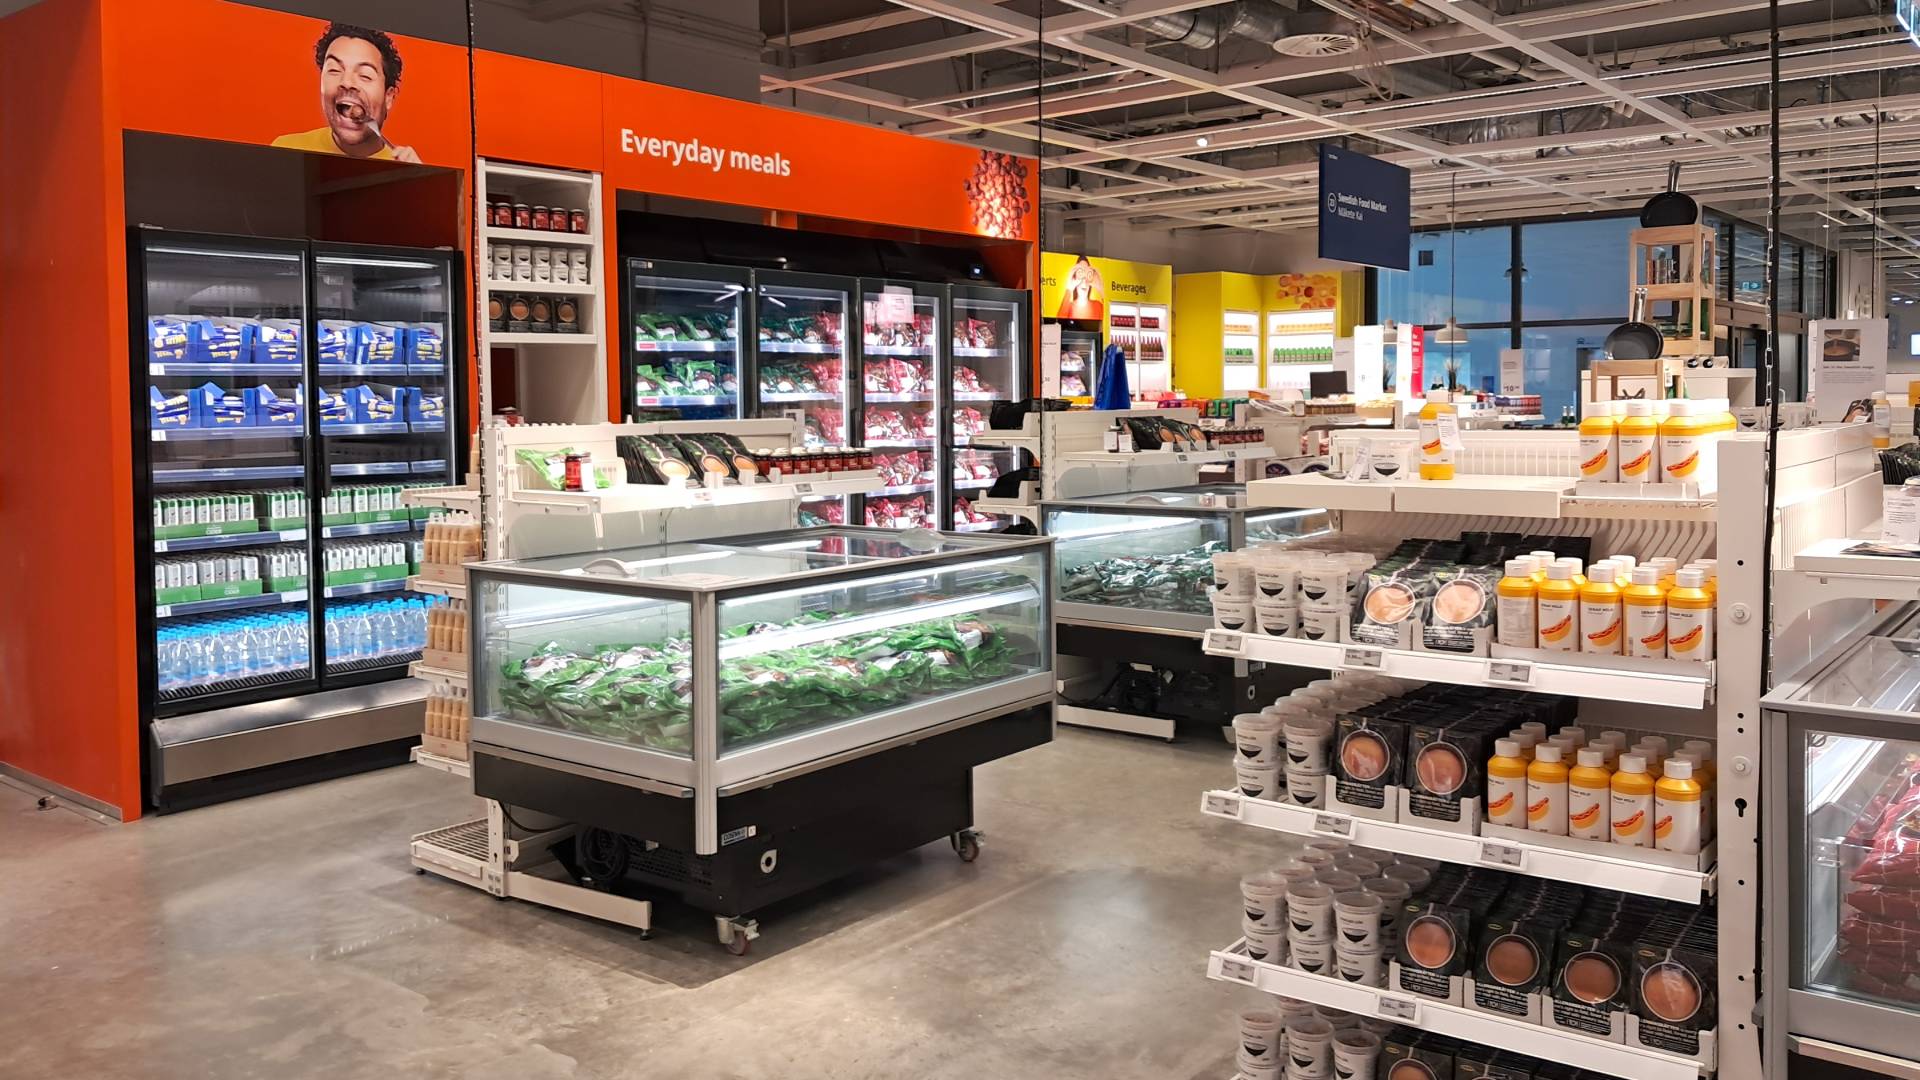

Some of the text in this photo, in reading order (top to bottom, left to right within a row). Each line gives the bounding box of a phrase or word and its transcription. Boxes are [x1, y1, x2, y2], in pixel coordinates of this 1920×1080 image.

[621, 128, 791, 177] Everyday meals
[1338, 192, 1387, 213] Swedish Food Market
[1111, 281, 1147, 295] Beverages
